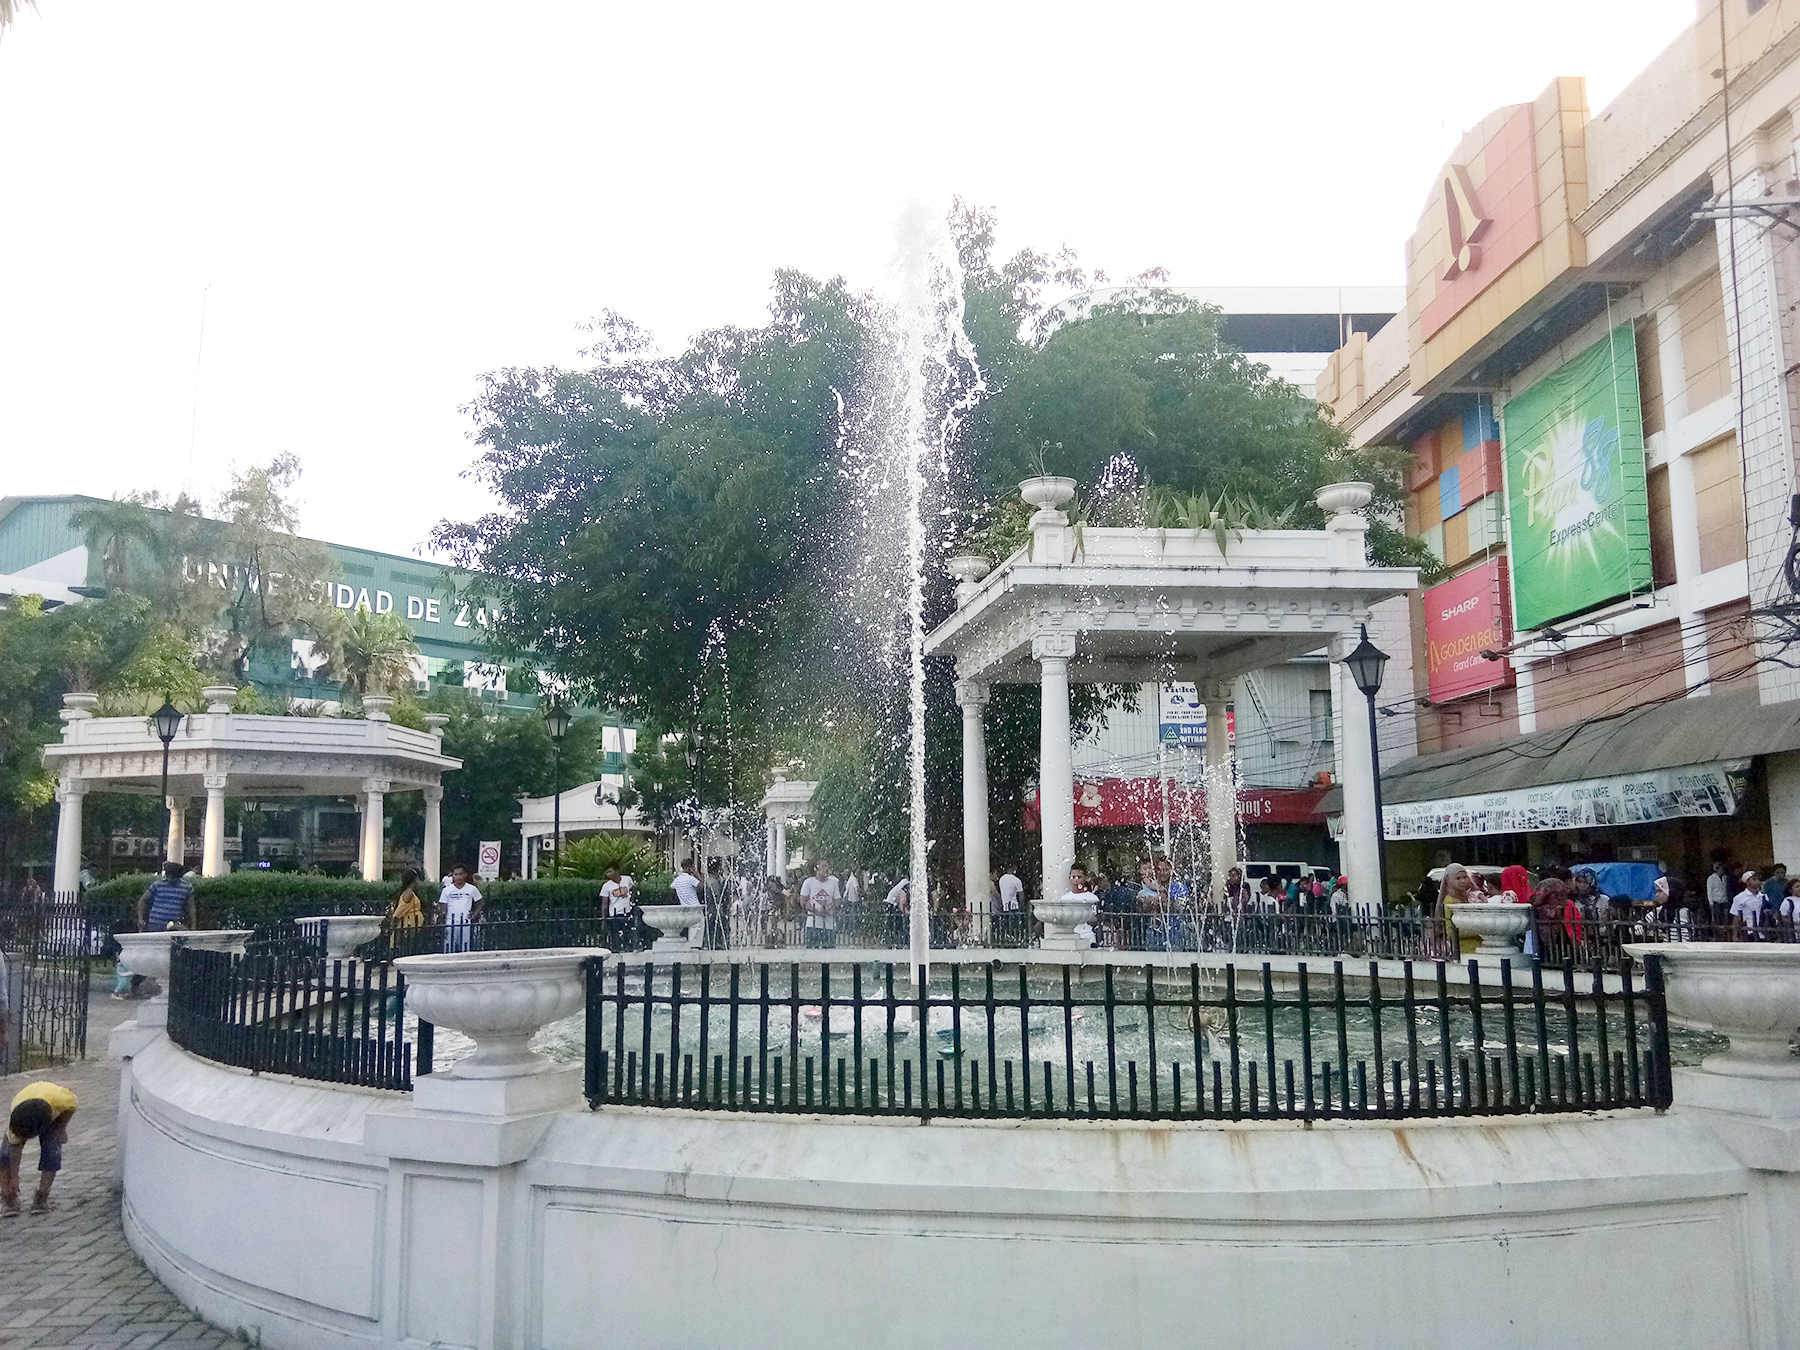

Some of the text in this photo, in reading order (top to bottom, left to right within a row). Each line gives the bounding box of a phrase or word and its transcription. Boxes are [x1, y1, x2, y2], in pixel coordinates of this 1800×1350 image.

[181, 552, 393, 615] UNIVEIDAD
[406, 595, 441, 623] DE
[1441, 597, 1479, 621] SHARP
[1453, 656, 1469, 672] Grand
[1622, 781, 1657, 796] APPLIANCES
